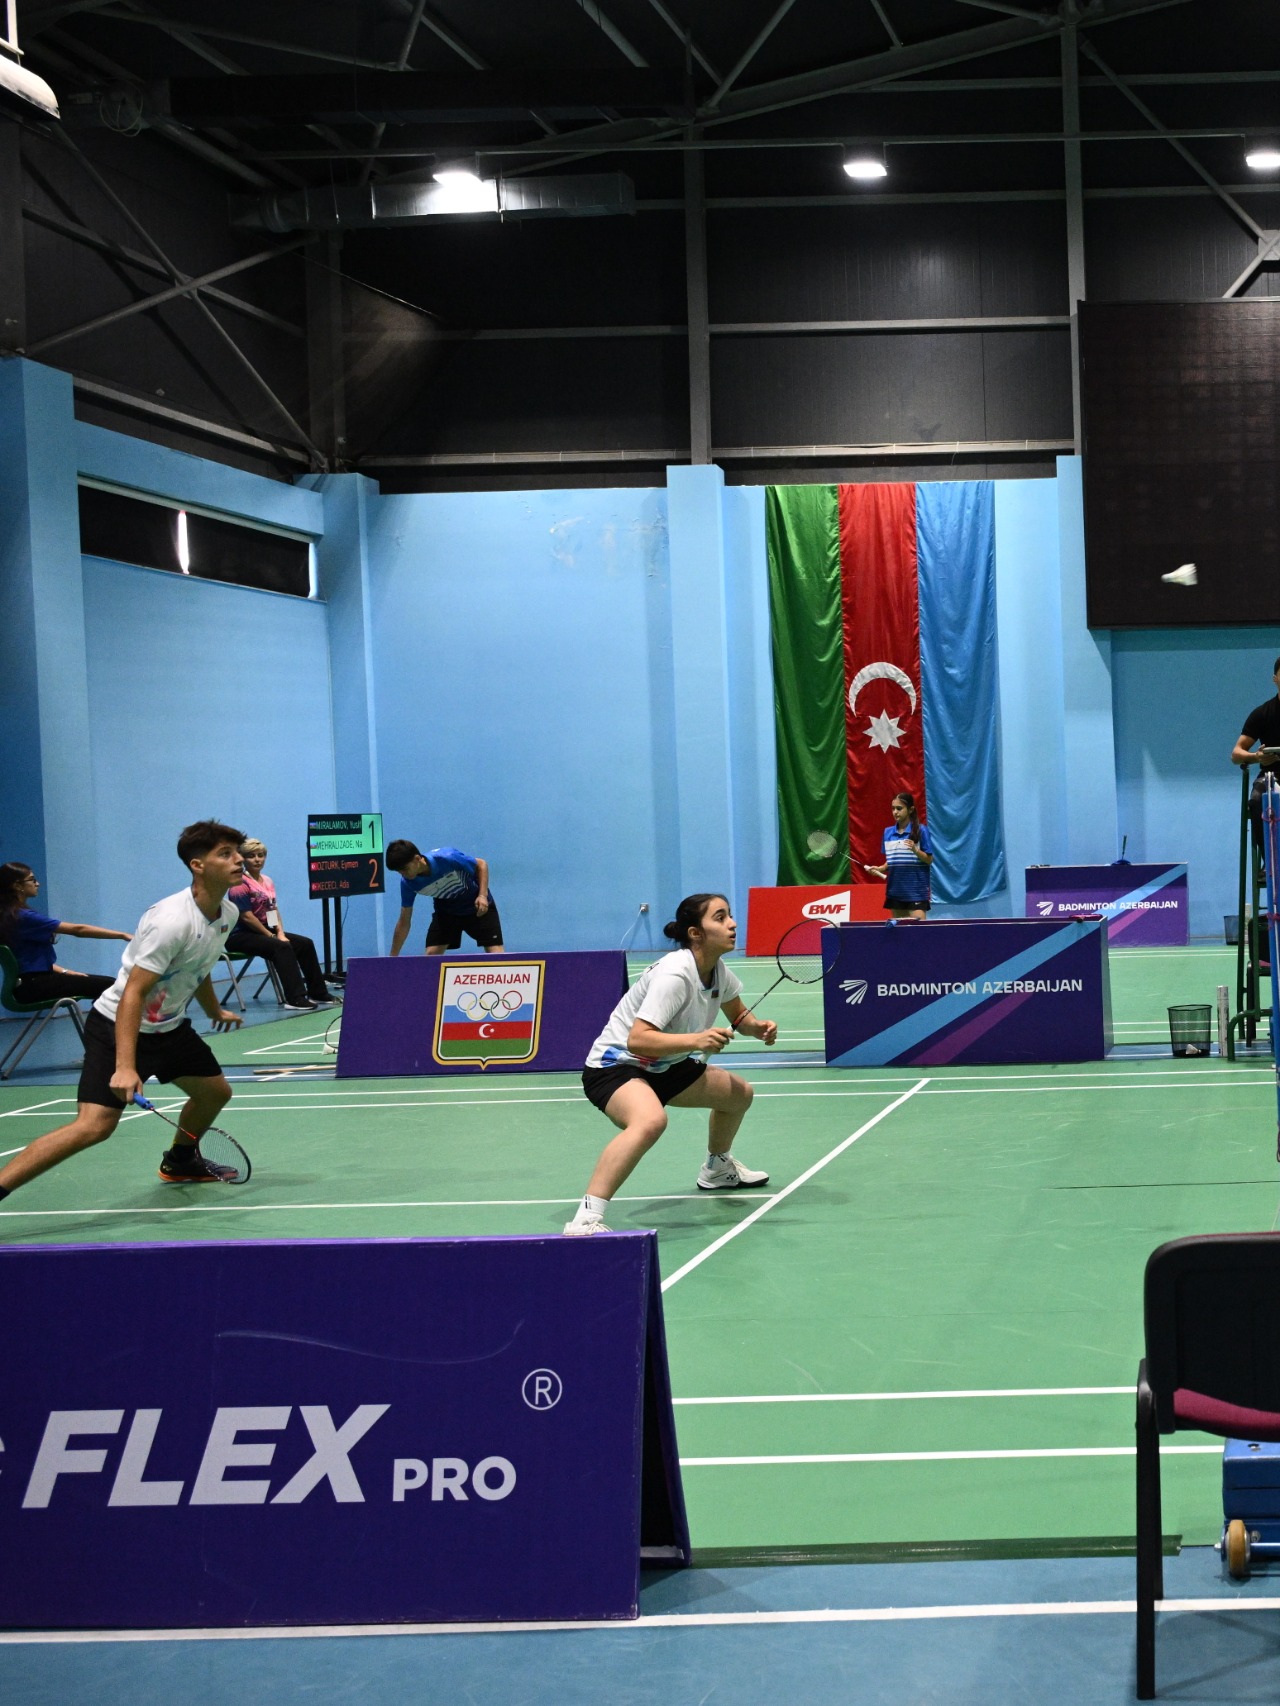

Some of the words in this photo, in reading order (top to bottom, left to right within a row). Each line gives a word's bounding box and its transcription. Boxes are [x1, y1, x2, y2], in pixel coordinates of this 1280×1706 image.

[368, 820, 375, 849] 1
[369, 858, 379, 888] 2
[808, 903, 847, 915] BWF
[1058, 902, 1116, 912] BADMINTON
[1119, 900, 1178, 910] AZERBAIJAN
[453, 974, 531, 985] AZERBAIJAN
[877, 982, 976, 997] BADMINTON
[982, 979, 1083, 995] AZERBAIJAN
[21, 1403, 392, 1509] FLEX
[392, 1456, 517, 1502] PRO
